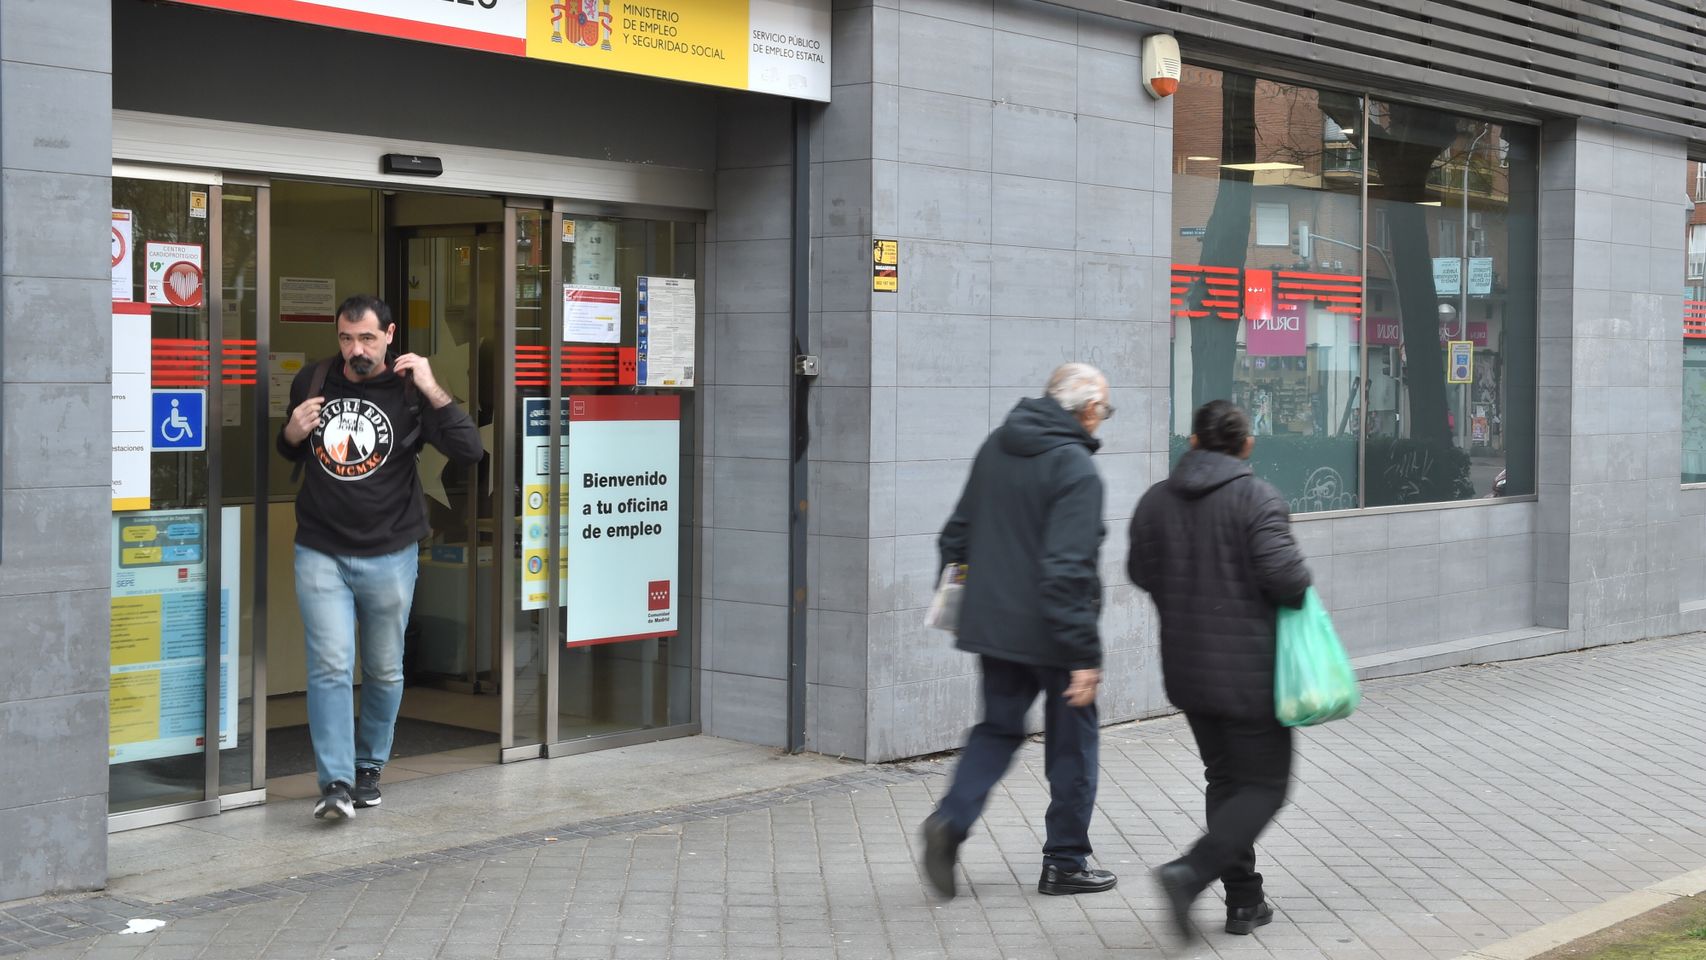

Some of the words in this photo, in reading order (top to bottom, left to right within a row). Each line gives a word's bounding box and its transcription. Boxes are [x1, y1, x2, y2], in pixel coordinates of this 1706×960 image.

[624, 4, 679, 23] MINISTERIO
[624, 19, 636, 30] DE
[640, 21, 677, 37] EMPLEO
[623, 33, 630, 44] Y
[633, 35, 689, 53] SEGURIDAD
[692, 45, 725, 60] SOCIAL
[753, 30, 786, 44] SERVICIO
[788, 34, 820, 50] PÚBLICO
[753, 44, 763, 53] DE
[765, 46, 795, 58] EMPLEO
[796, 51, 825, 63] ESTATAL
[314, 401, 361, 436] FUTURE
[364, 406, 389, 444] EDTN
[335, 452, 382, 476] MCMXC
[583, 471, 667, 488] Bienvenido
[582, 504, 591, 515] a
[596, 500, 612, 514] tu
[617, 497, 668, 514] oficina
[582, 524, 601, 539] de
[606, 521, 662, 539] empleo
